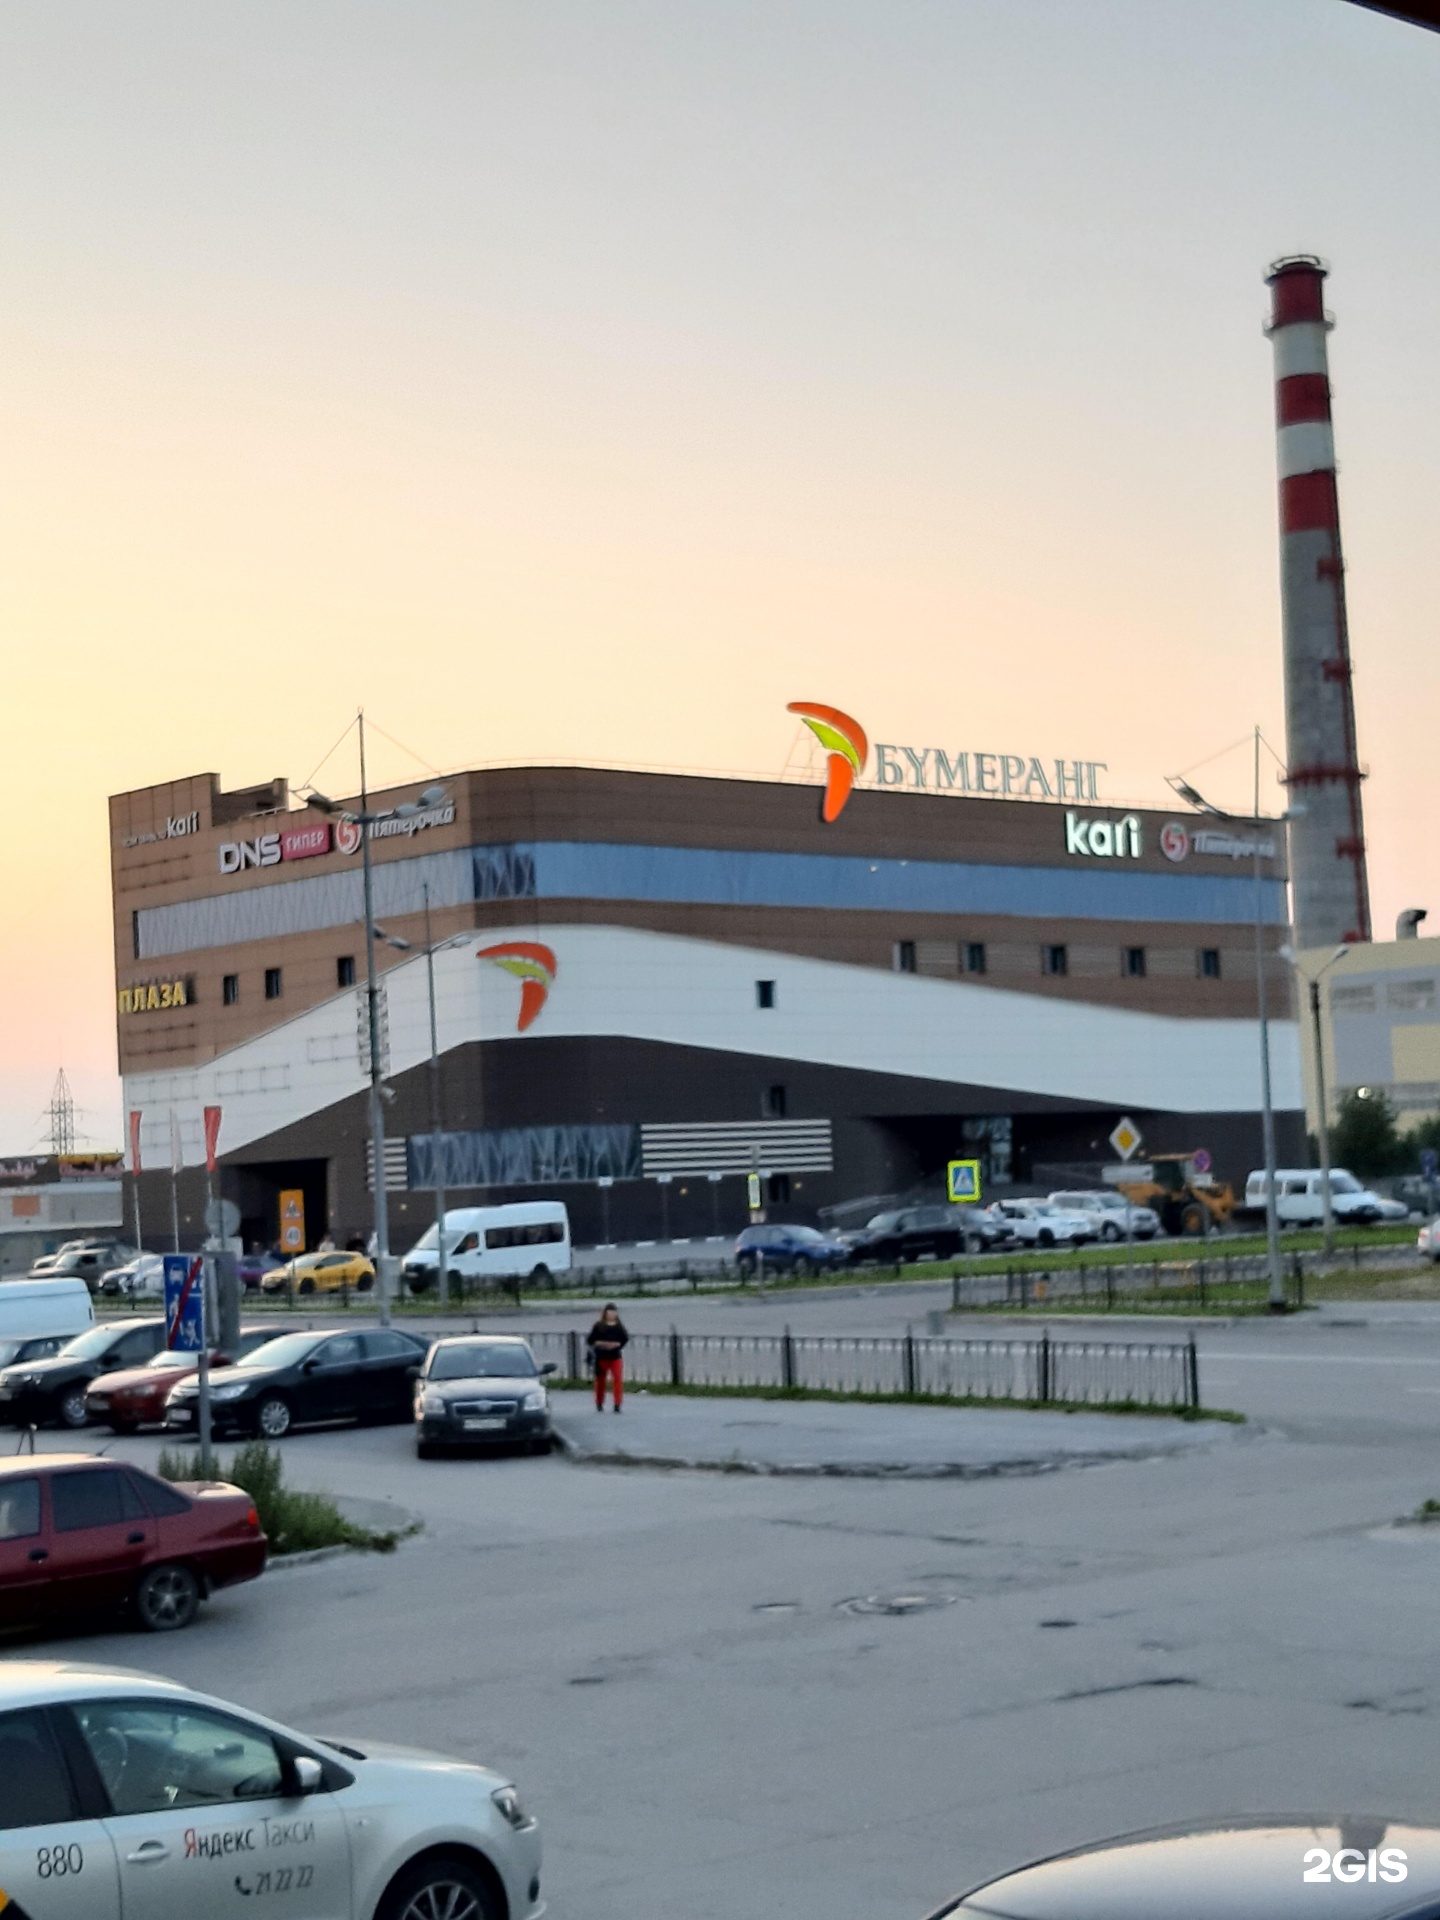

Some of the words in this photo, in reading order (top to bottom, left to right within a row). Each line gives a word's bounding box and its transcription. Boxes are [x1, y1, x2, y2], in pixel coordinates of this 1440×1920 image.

[874, 743, 1108, 801] БУМЕРАНГ
[219, 832, 281, 874] DNS
[286, 831, 324, 853] ГИПЕР
[1065, 811, 1141, 858] kari
[118, 981, 187, 1014] ПЛАЗА
[183, 1827, 255, 1859] Яндекс
[261, 1817, 316, 1847] Такси
[36, 1842, 83, 1878] 880
